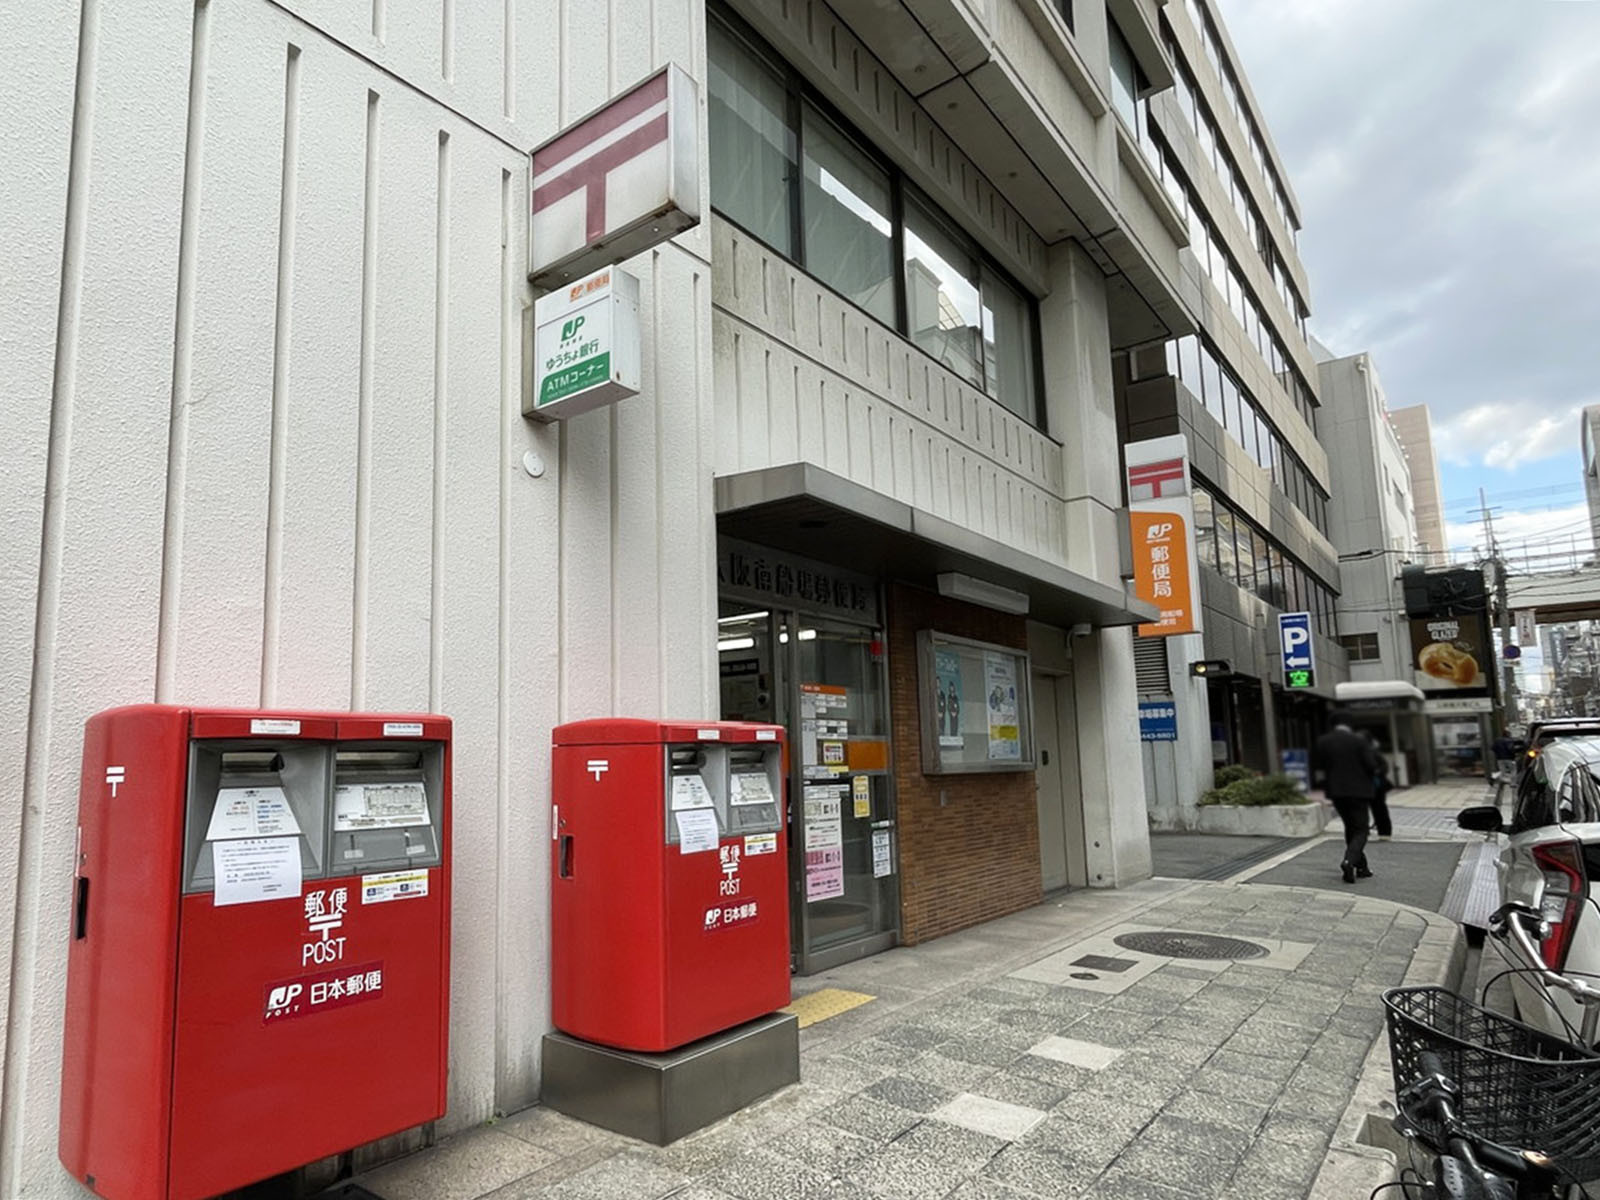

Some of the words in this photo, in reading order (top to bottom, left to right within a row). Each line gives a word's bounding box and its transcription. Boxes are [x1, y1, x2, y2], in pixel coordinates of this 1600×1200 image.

[546, 339, 599, 370] ゆうちょ銀行
[547, 364, 604, 391] ATMコーナー
[1151, 545, 1173, 599] 郵便局
[1283, 628, 1308, 654] P
[719, 844, 742, 865] 郵便
[719, 878, 741, 897] POST
[305, 889, 348, 919] 郵便
[723, 901, 758, 924] 日本郵便
[303, 938, 346, 967] POST
[310, 969, 382, 1005] 日本郵便
